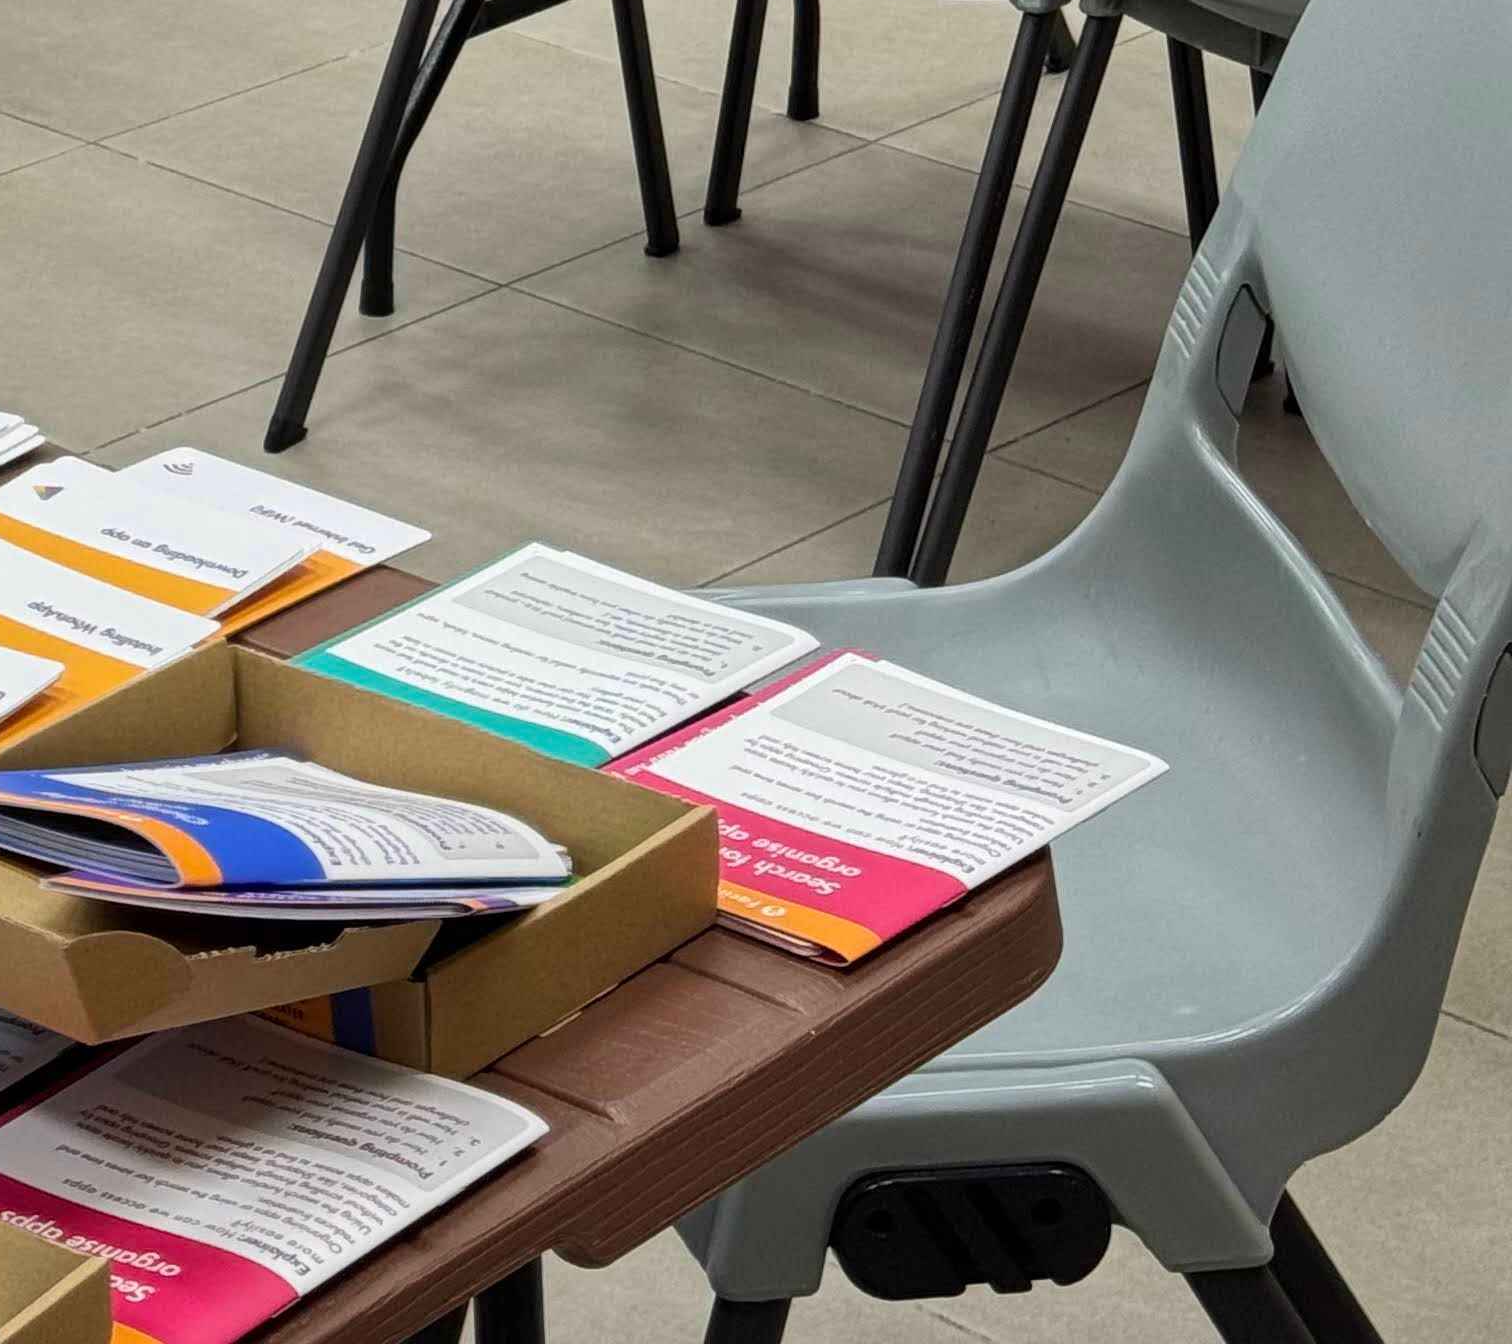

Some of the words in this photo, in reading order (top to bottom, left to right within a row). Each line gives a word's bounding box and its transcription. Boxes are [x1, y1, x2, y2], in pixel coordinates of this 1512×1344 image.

[101, 528, 131, 541] app
[131, 539, 153, 549] an
[292, 521, 349, 544] Internet
[347, 542, 376, 554] Get
[152, 544, 249, 579] Downloading
[28, 602, 98, 635] WhatsApp
[100, 628, 163, 657] Installing
[752, 839, 862, 877] organise
[754, 860, 841, 895] Search
[283, 1121, 358, 1147] questions:
[358, 1142, 434, 1180] Prompting
[62, 1179, 98, 1194] apps
[100, 1192, 146, 1209] access
[149, 1208, 170, 1217] we
[0, 1210, 63, 1242] apps
[173, 1215, 201, 1226] can
[204, 1224, 238, 1239] How
[230, 1220, 285, 1241] easily?
[280, 1216, 343, 1255] Organising
[65, 1235, 182, 1278] organise
[236, 1234, 311, 1277] Explainer:
[286, 1240, 325, 1265] more
